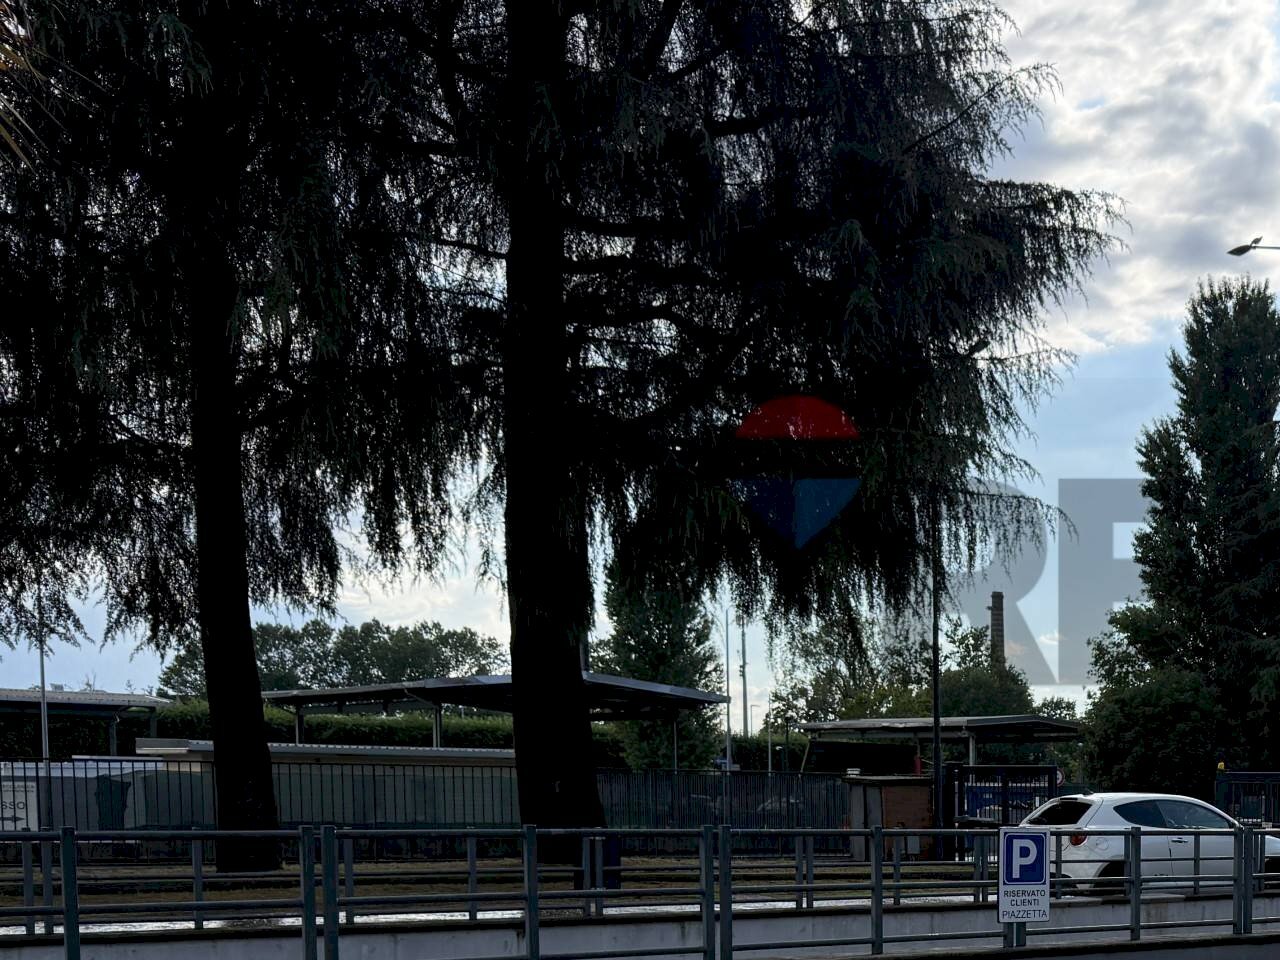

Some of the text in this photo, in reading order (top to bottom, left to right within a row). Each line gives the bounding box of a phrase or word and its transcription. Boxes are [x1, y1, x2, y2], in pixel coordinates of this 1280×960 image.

[1012, 839, 1037, 879] P
[1003, 889, 1046, 898] RISERVATO
[1010, 899, 1040, 907] CLIENTI
[1002, 909, 1047, 919] PIAZZETTA
